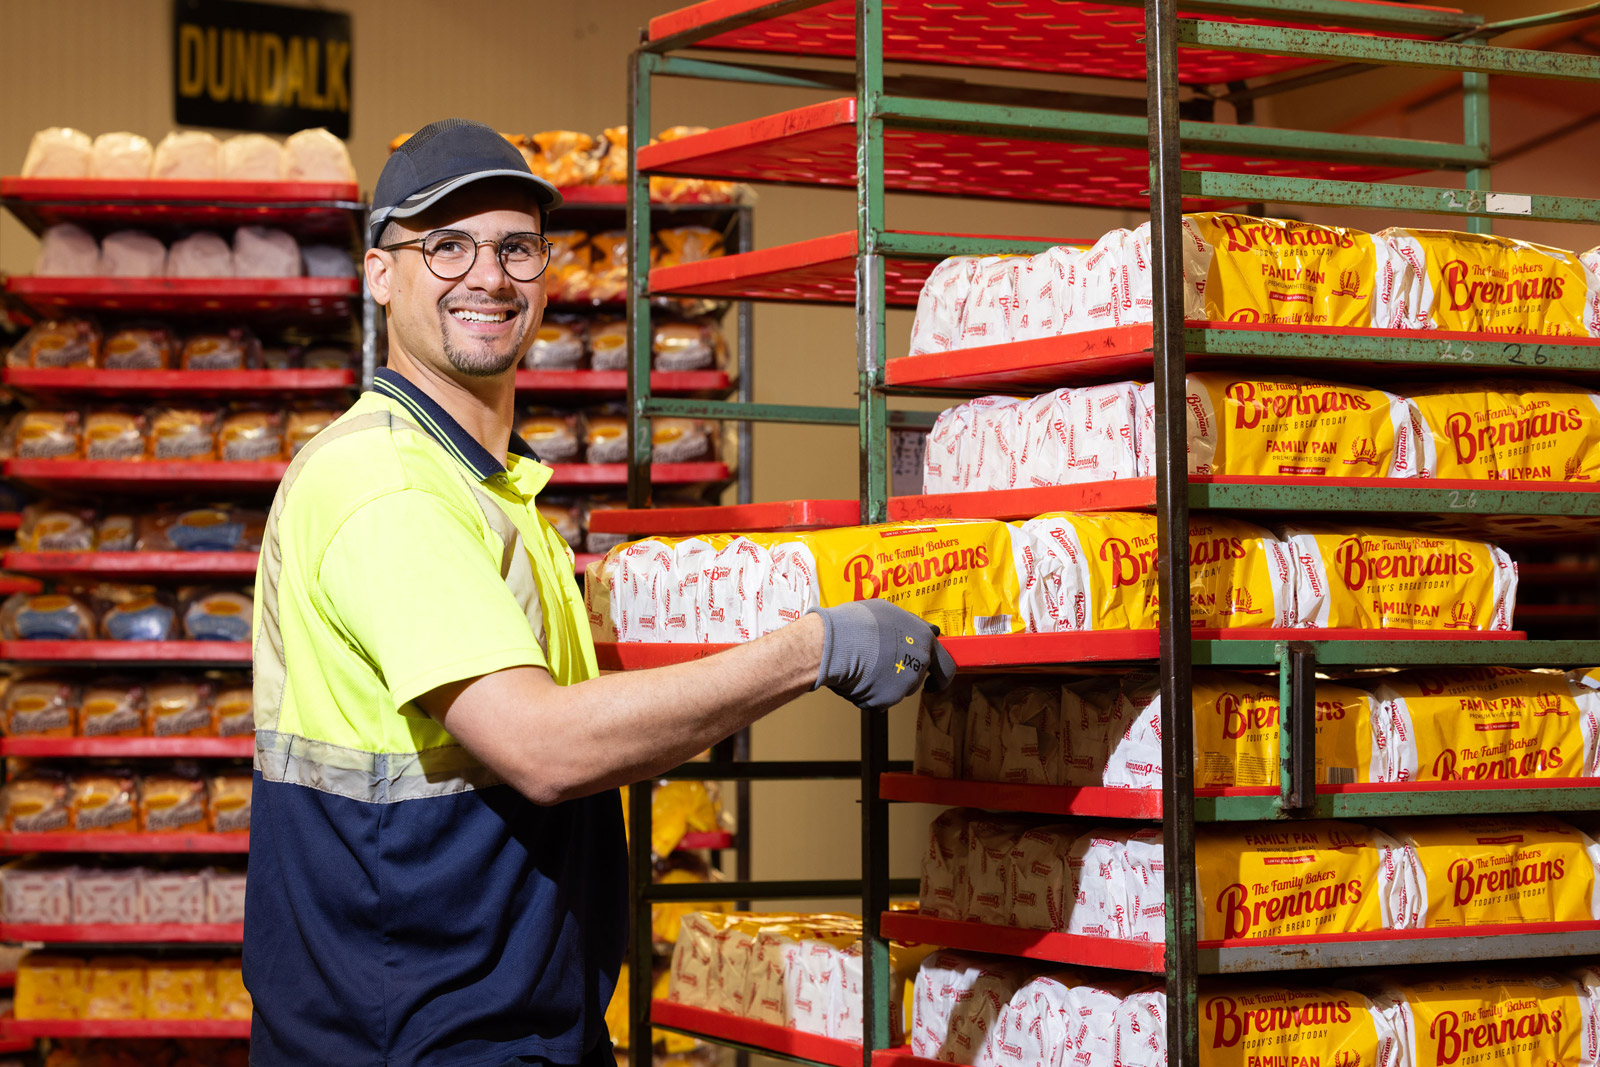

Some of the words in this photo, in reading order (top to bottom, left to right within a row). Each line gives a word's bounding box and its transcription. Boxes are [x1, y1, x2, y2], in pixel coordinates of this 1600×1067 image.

[179, 24, 350, 112] DUNDALK
[1211, 215, 1353, 252] Brennans
[1284, 248, 1308, 257] BREAD
[1305, 269, 1325, 285] PAN
[1511, 263, 1543, 274] Bakers
[1121, 264, 1132, 311] Brennans
[1381, 260, 1394, 304] Brennans
[1441, 260, 1565, 311] Brennans
[1304, 312, 1327, 322] Bkers
[1440, 340, 1475, 361] 26
[1503, 343, 1548, 366] 26
[1257, 382, 1273, 392] The
[1186, 394, 1208, 438] Brennans
[1225, 381, 1372, 430] Brennans
[1474, 411, 1487, 423] Th
[1262, 424, 1289, 433] TODAY'S
[1294, 419, 1317, 430] BREAD
[1321, 416, 1347, 426] TODAY
[1266, 440, 1308, 454] FAMILY
[1312, 441, 1337, 455] PAN
[1360, 438, 1371, 457] 1st
[1444, 408, 1583, 466] Brennans
[1532, 440, 1557, 452] TODAY
[1395, 426, 1408, 472] Brennans
[1525, 465, 1551, 479] PAN
[1049, 527, 1078, 565] Brennans
[1131, 537, 1149, 549] The
[1189, 525, 1213, 537] akers
[1363, 540, 1380, 552] The
[1381, 540, 1412, 552] Family
[1413, 538, 1445, 550] Bakers
[877, 553, 894, 565] The
[895, 546, 925, 560] Family
[926, 538, 960, 552] Bakers
[1100, 536, 1246, 589] Breans
[844, 545, 989, 601] Brennans
[1194, 567, 1221, 579] TODAY
[1299, 553, 1322, 598] Brennans
[1336, 537, 1474, 591] Brennans
[887, 590, 911, 603] ODAY'S
[916, 583, 941, 597] BREAD
[943, 575, 969, 589] TODAY
[1235, 587, 1245, 607] 1st
[1399, 582, 1422, 591] BREAD
[1423, 580, 1450, 590] TODAY
[1414, 604, 1440, 618] PAN
[1414, 618, 1432, 626] BREAD
[1458, 602, 1469, 621] 1st
[1501, 697, 1526, 710] PAN
[1216, 692, 1346, 740] Brenns
[1460, 749, 1478, 761] The
[1480, 742, 1508, 757] Family
[1508, 737, 1538, 751] Bakers
[1432, 747, 1563, 781] Brennans
[1244, 833, 1289, 846] FAMILY
[1294, 832, 1319, 844] PAN
[1476, 858, 1489, 869] The
[1491, 854, 1513, 866] Family
[1252, 883, 1269, 896] The
[1271, 876, 1303, 892] Family
[1305, 870, 1336, 885] Bakers
[1447, 858, 1565, 908] Brennans
[1474, 896, 1502, 907] TODAY'S
[1523, 887, 1546, 898] TODAY
[1216, 879, 1362, 940] Brennans
[1252, 925, 1282, 938] TODAY'S
[1286, 919, 1311, 932] BREAD
[1315, 913, 1337, 926] TODAY
[1239, 996, 1255, 1007] The
[1255, 992, 1286, 1005] Family
[1205, 996, 1351, 1049] Brennans
[1462, 1011, 1476, 1023] The
[1478, 1005, 1503, 1020] Family
[1505, 1000, 1538, 1013] Bakers
[1242, 1037, 1272, 1050] TODAY'S
[1276, 1033, 1299, 1045] BREAD
[1301, 1029, 1328, 1041] TODAY
[1430, 1010, 1562, 1067] Brennans
[1248, 1056, 1290, 1067] FAMILY
[1291, 1056, 1320, 1067] PAN
[1462, 1051, 1491, 1066] TODAY'S
[1515, 1040, 1541, 1055] TODAY
